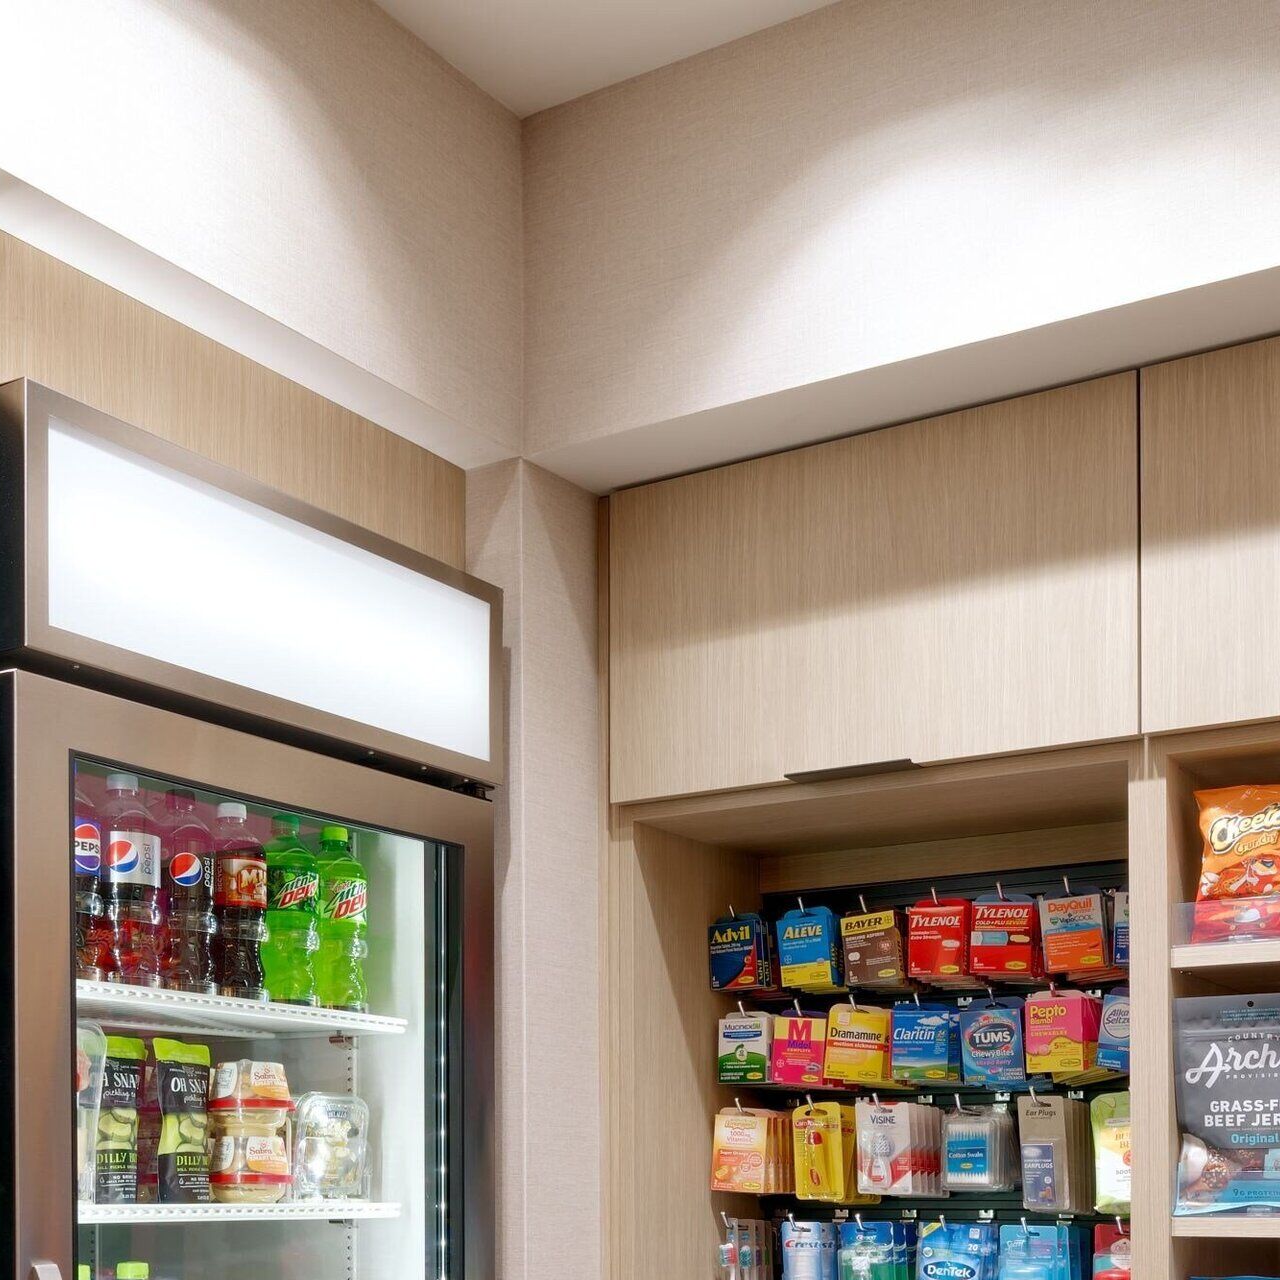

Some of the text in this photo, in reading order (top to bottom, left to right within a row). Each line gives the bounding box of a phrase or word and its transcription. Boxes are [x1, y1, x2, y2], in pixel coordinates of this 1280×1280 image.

[142, 842, 152, 876] pepsi
[975, 906, 1030, 919] TYLENOL
[1048, 899, 1092, 914] DayQuil
[845, 916, 883, 931] BAYER
[910, 915, 961, 929] TYLENOL
[712, 926, 751, 944] Advil
[1030, 1005, 1067, 1019] Pepto
[830, 1027, 882, 1042] Dramamine
[893, 1027, 935, 1041] Claritin
[973, 1031, 1012, 1043] TUMS
[253, 1072, 277, 1081] Sabra
[870, 1115, 896, 1125] VISINE
[1204, 1113, 1245, 1127] BEEF
[1231, 1132, 1280, 1145] Original
[97, 1152, 128, 1167] DILLY
[176, 1154, 201, 1168] DILLY
[927, 1264, 972, 1278] DenTek
